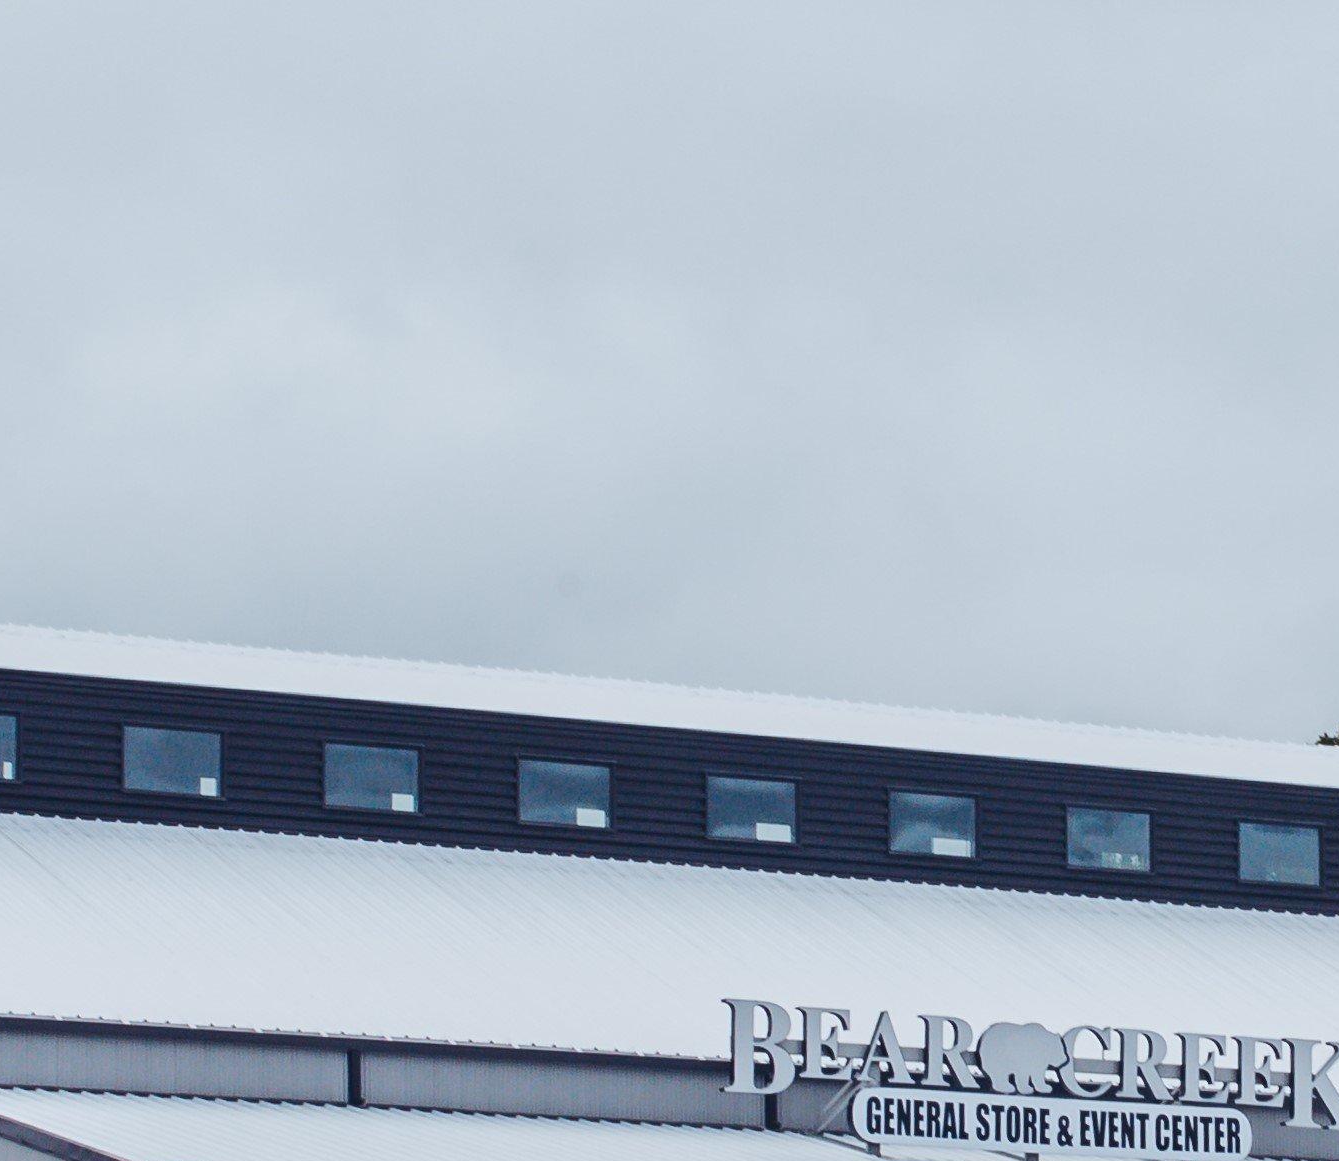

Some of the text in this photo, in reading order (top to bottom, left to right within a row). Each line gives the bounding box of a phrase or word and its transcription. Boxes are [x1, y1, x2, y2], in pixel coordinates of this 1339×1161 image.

[720, 998, 981, 1094] BEAR
[866, 1096, 1242, 1154] GENERAL STORE & EVENT CENTER
